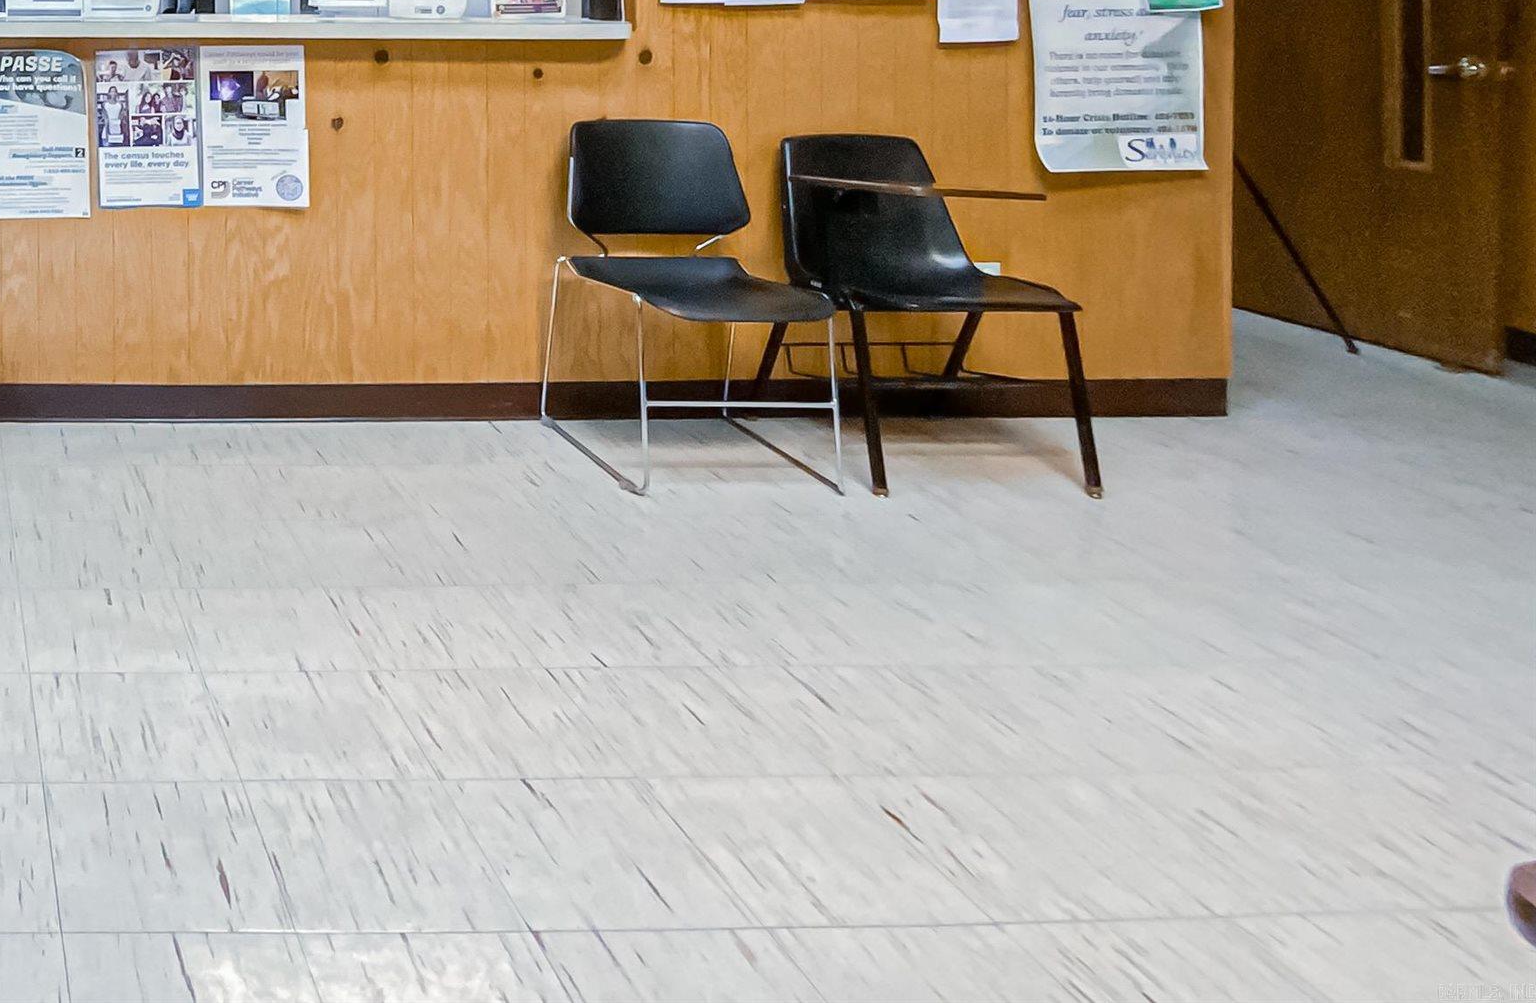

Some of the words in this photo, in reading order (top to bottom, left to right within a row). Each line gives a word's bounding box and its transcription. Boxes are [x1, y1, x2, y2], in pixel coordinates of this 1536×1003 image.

[0, 55, 63, 72] PASSE
[34, 76, 51, 85] you
[53, 74, 68, 83] call
[12, 83, 35, 91] have
[36, 83, 82, 92] questions?
[76, 149, 84, 157] 2
[104, 152, 119, 160] The
[151, 151, 185, 159] touches
[147, 161, 171, 169] every
[172, 160, 189, 168] day
